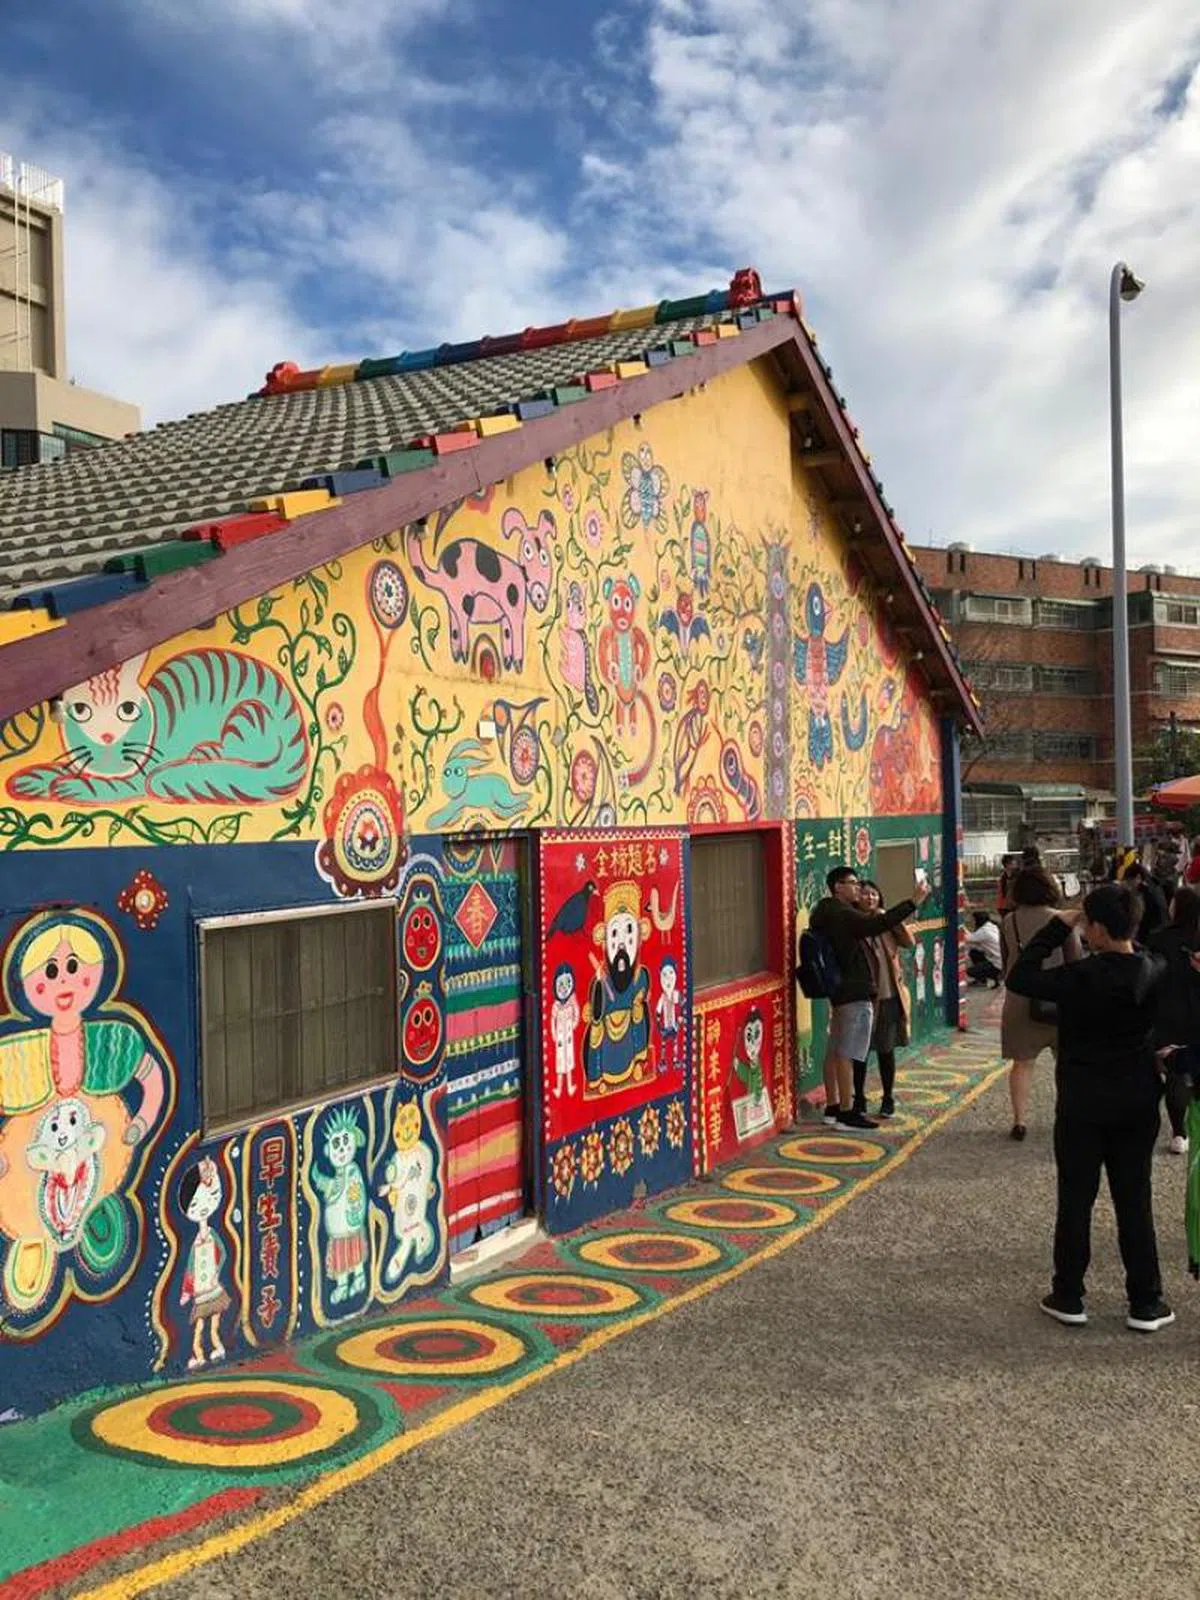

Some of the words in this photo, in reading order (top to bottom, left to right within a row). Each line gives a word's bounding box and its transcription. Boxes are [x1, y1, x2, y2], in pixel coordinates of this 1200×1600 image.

[592, 842, 656, 877] 金榜題名
[795, 829, 842, 861] 生一對
[466, 891, 488, 936] 春
[257, 1136, 285, 1328] 早生貴子
